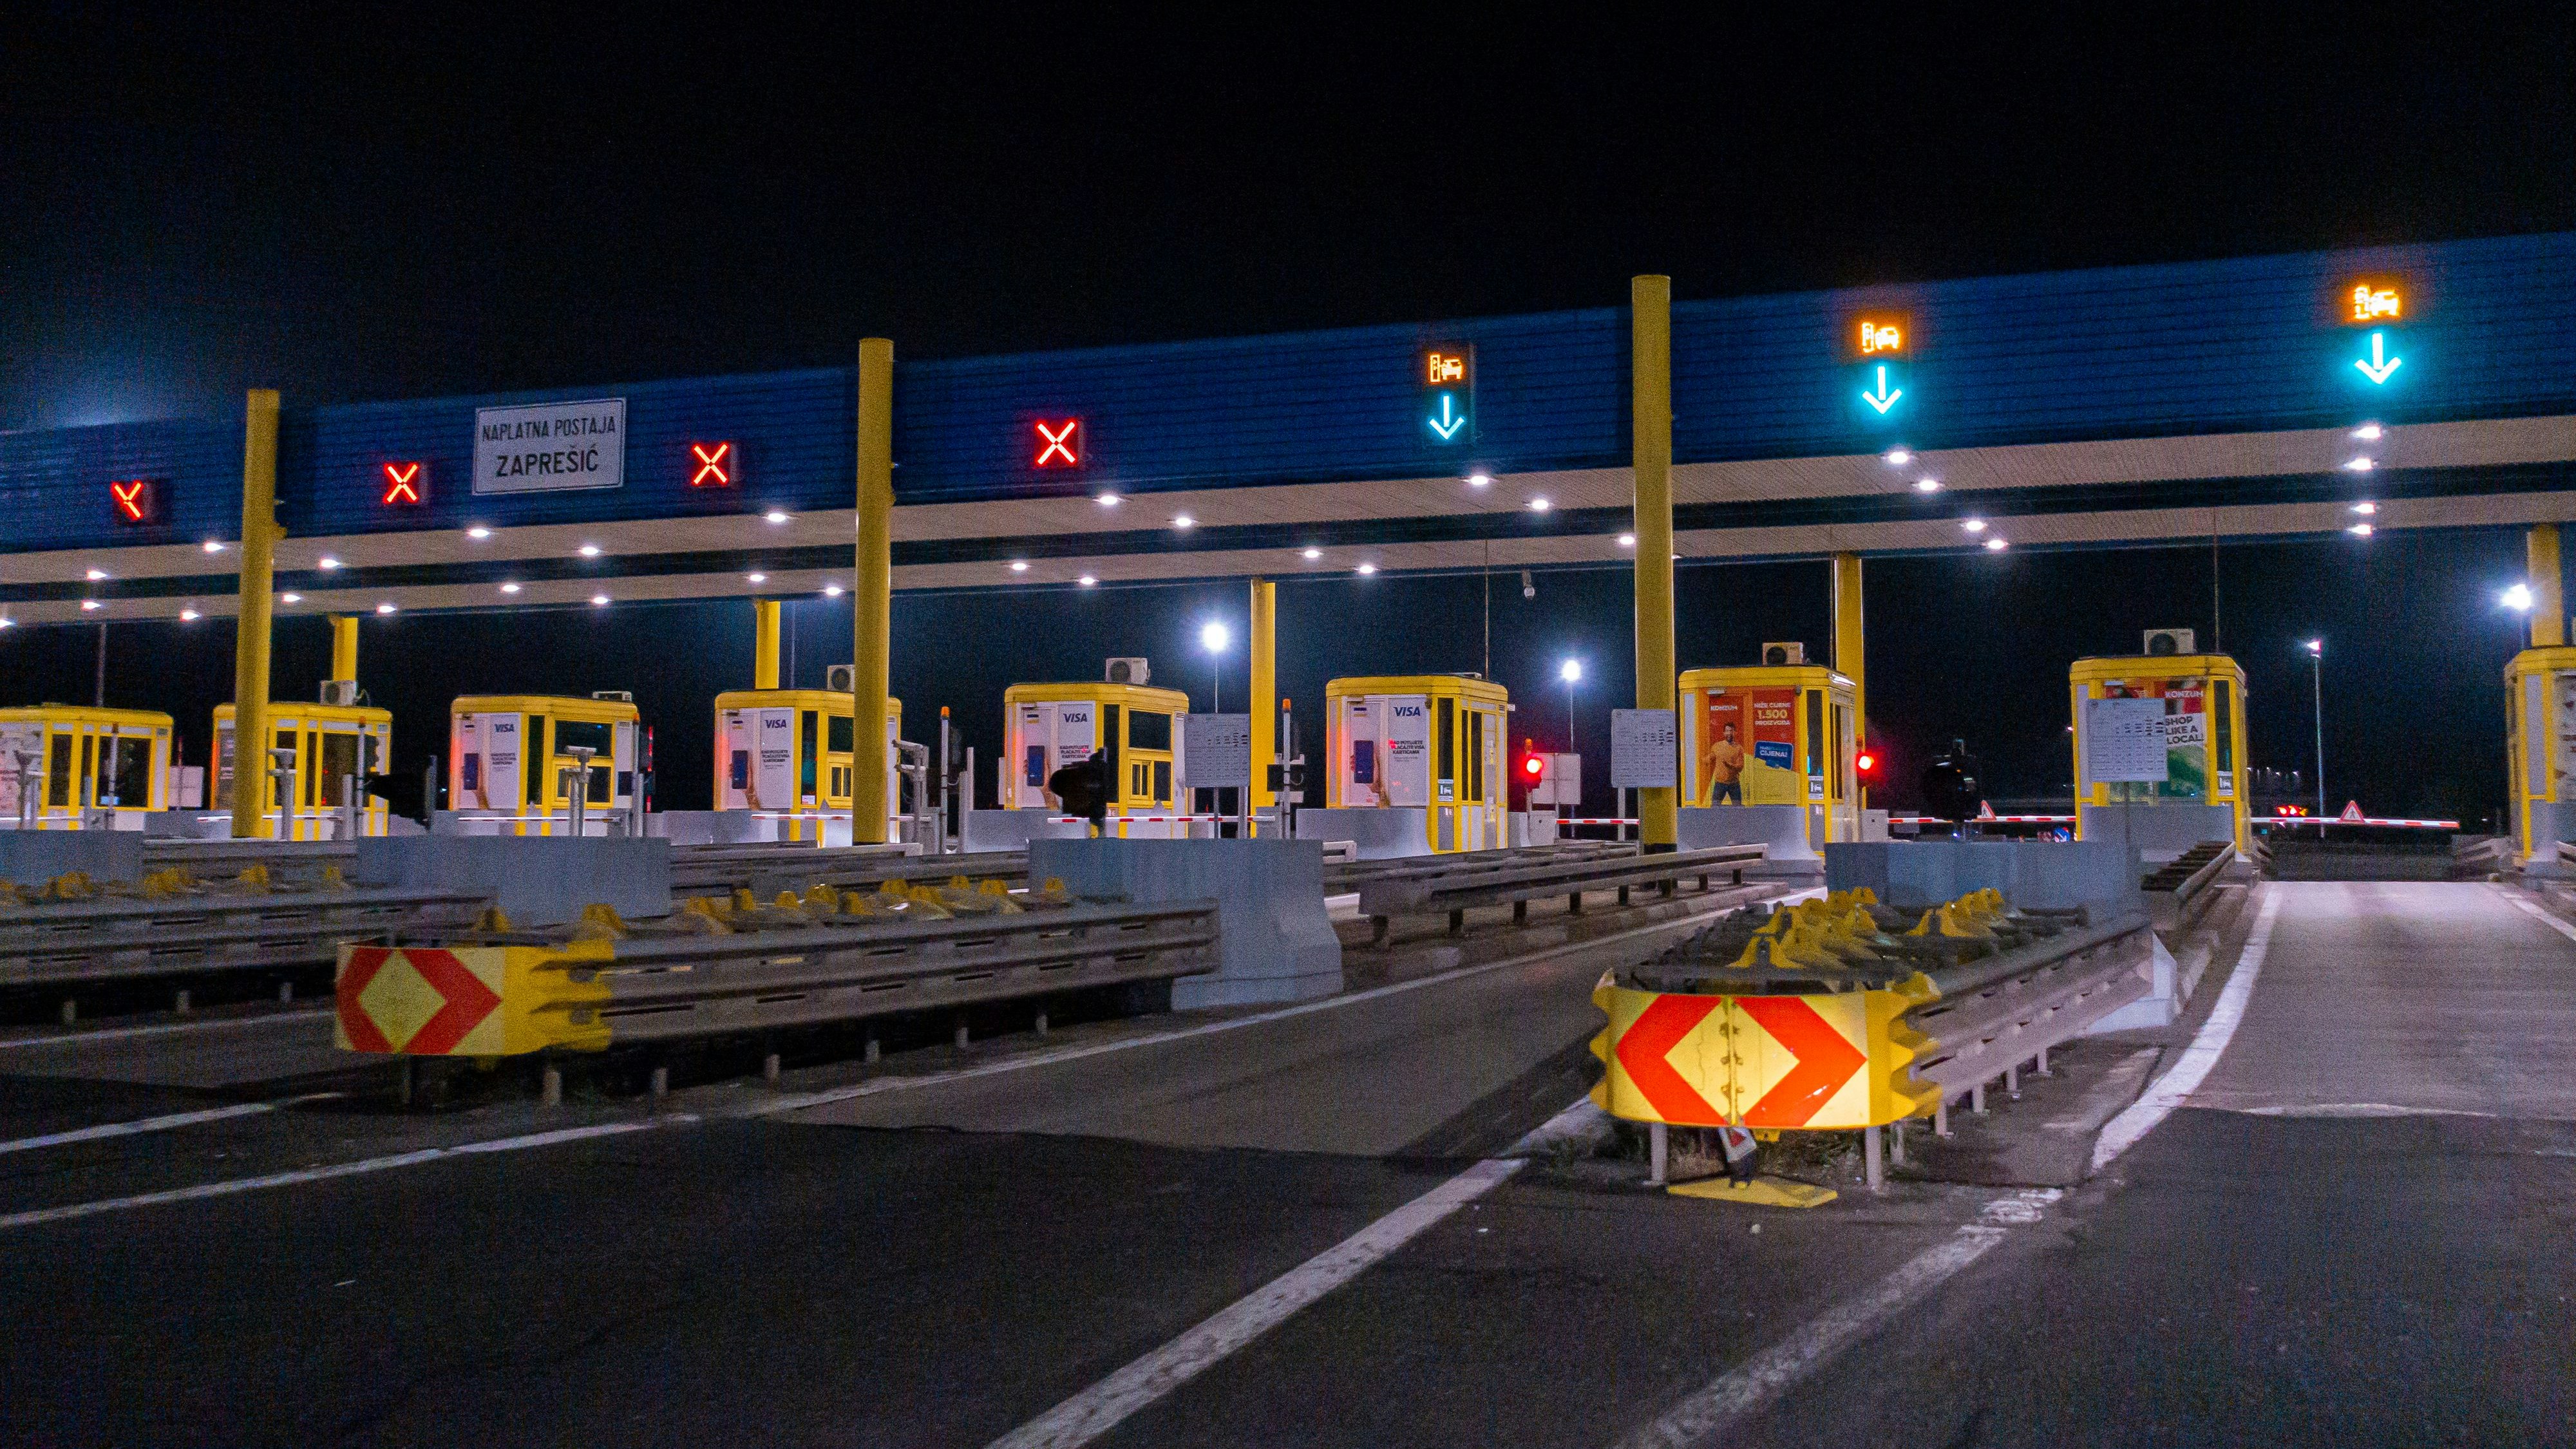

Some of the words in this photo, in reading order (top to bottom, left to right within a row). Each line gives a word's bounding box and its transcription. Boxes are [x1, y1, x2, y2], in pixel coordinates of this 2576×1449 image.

[482, 421, 549, 442] NAPLATNA
[554, 416, 616, 437] POSTAJA
[496, 443, 599, 477] ZAPREŠIĆ
[1394, 706, 1421, 716] VISA
[1063, 714, 1088, 722] VISA
[2165, 716, 2193, 726] SHOP
[495, 724, 515, 732] VISA
[765, 719, 787, 728] VISA
[2166, 726, 2188, 735] LIKE
